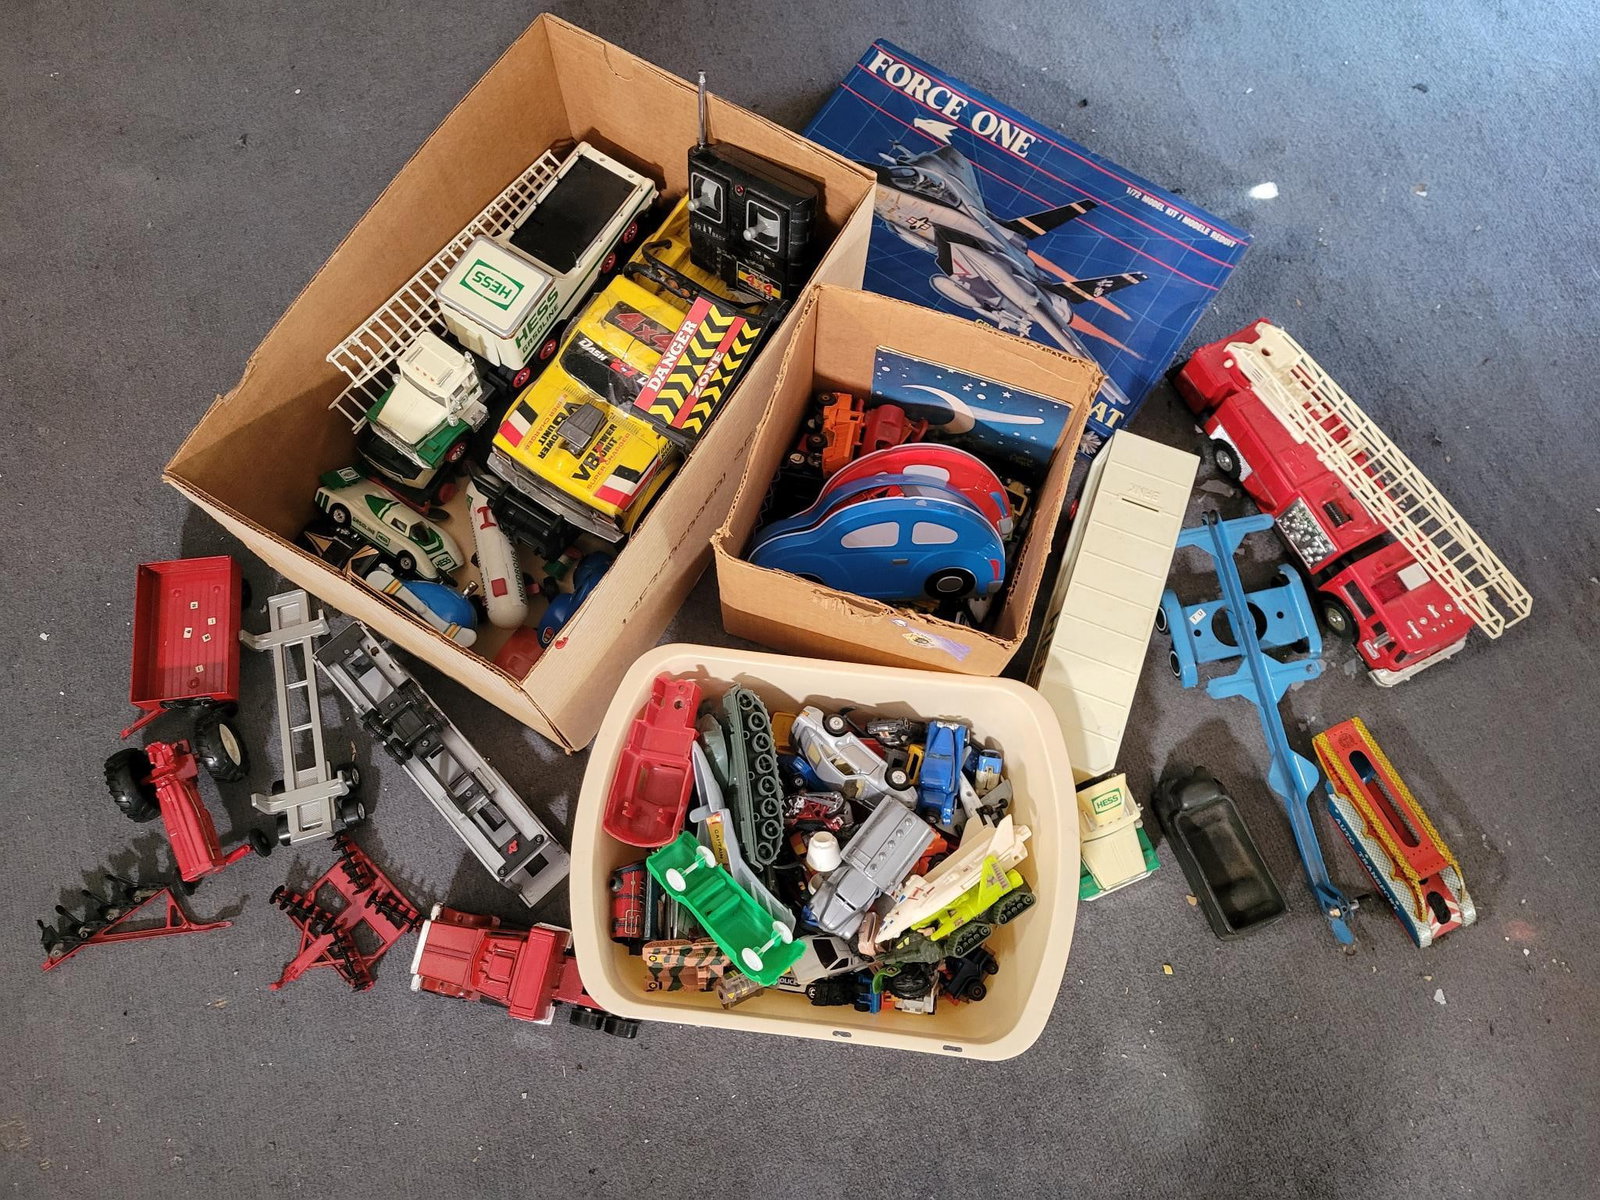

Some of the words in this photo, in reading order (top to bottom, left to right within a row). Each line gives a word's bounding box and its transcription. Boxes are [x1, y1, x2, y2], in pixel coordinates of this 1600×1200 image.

[868, 50, 968, 120] FORCE
[971, 110, 1037, 158] ONE
[1126, 186, 1142, 199] 1/72
[1141, 195, 1165, 212] MODEL
[1165, 207, 1179, 218] KIT
[472, 271, 512, 299] HESS
[515, 287, 559, 349] HESS
[522, 304, 559, 354] GASOLINE
[577, 337, 608, 362] DASH
[646, 320, 698, 393] DANGER
[690, 351, 724, 399] ZONE
[538, 424, 556, 446] UNIT
[572, 451, 602, 481] V8
[435, 556, 452, 567] HESS
[1096, 795, 1119, 809] HESS
[1335, 818, 1356, 846] AUTO
[779, 977, 798, 986] OLICE
